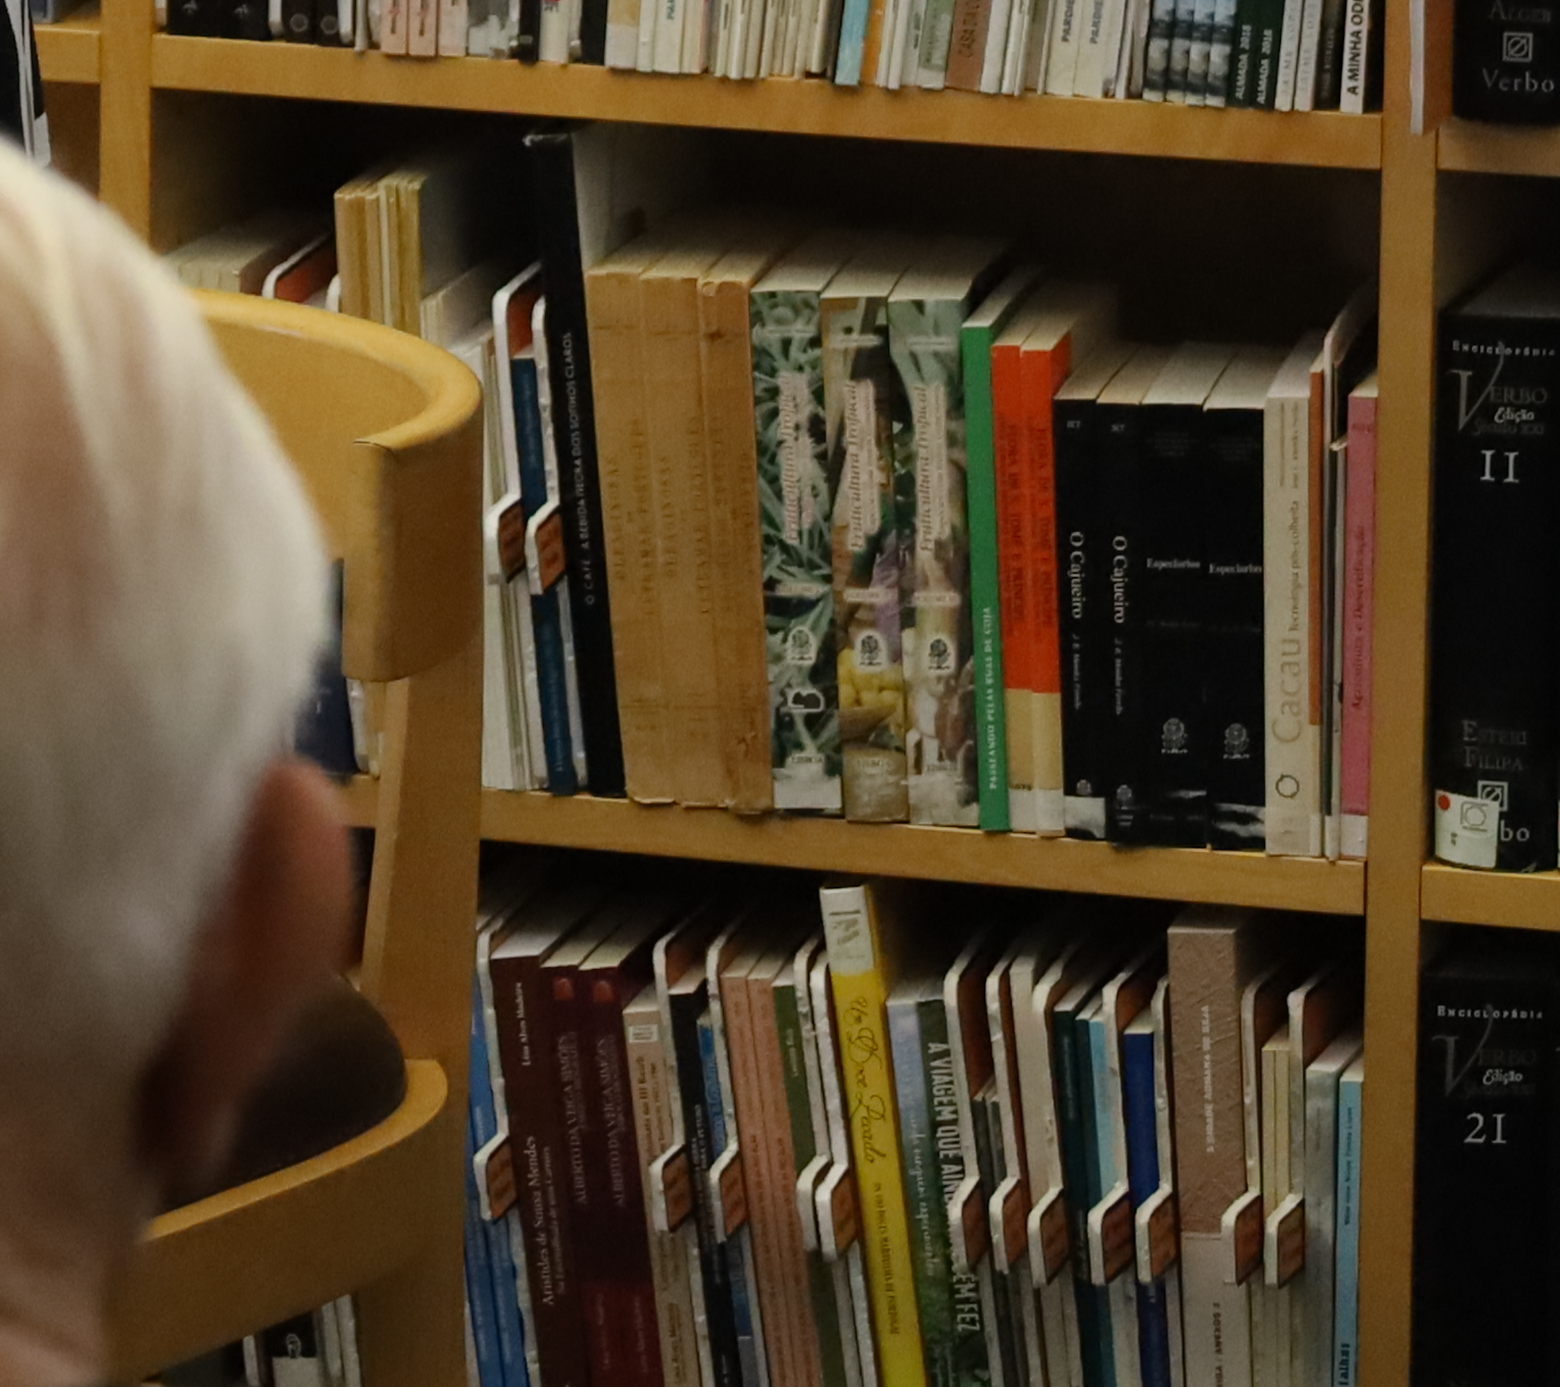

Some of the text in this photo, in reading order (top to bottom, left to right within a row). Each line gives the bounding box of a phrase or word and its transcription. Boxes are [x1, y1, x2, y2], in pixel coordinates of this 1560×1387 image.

[1348, 30, 1362, 80] MINHA
[1348, 85, 1359, 95] A
[1110, 536, 1129, 623] O Cajueiro
[1464, 1112, 1507, 1144] 21
